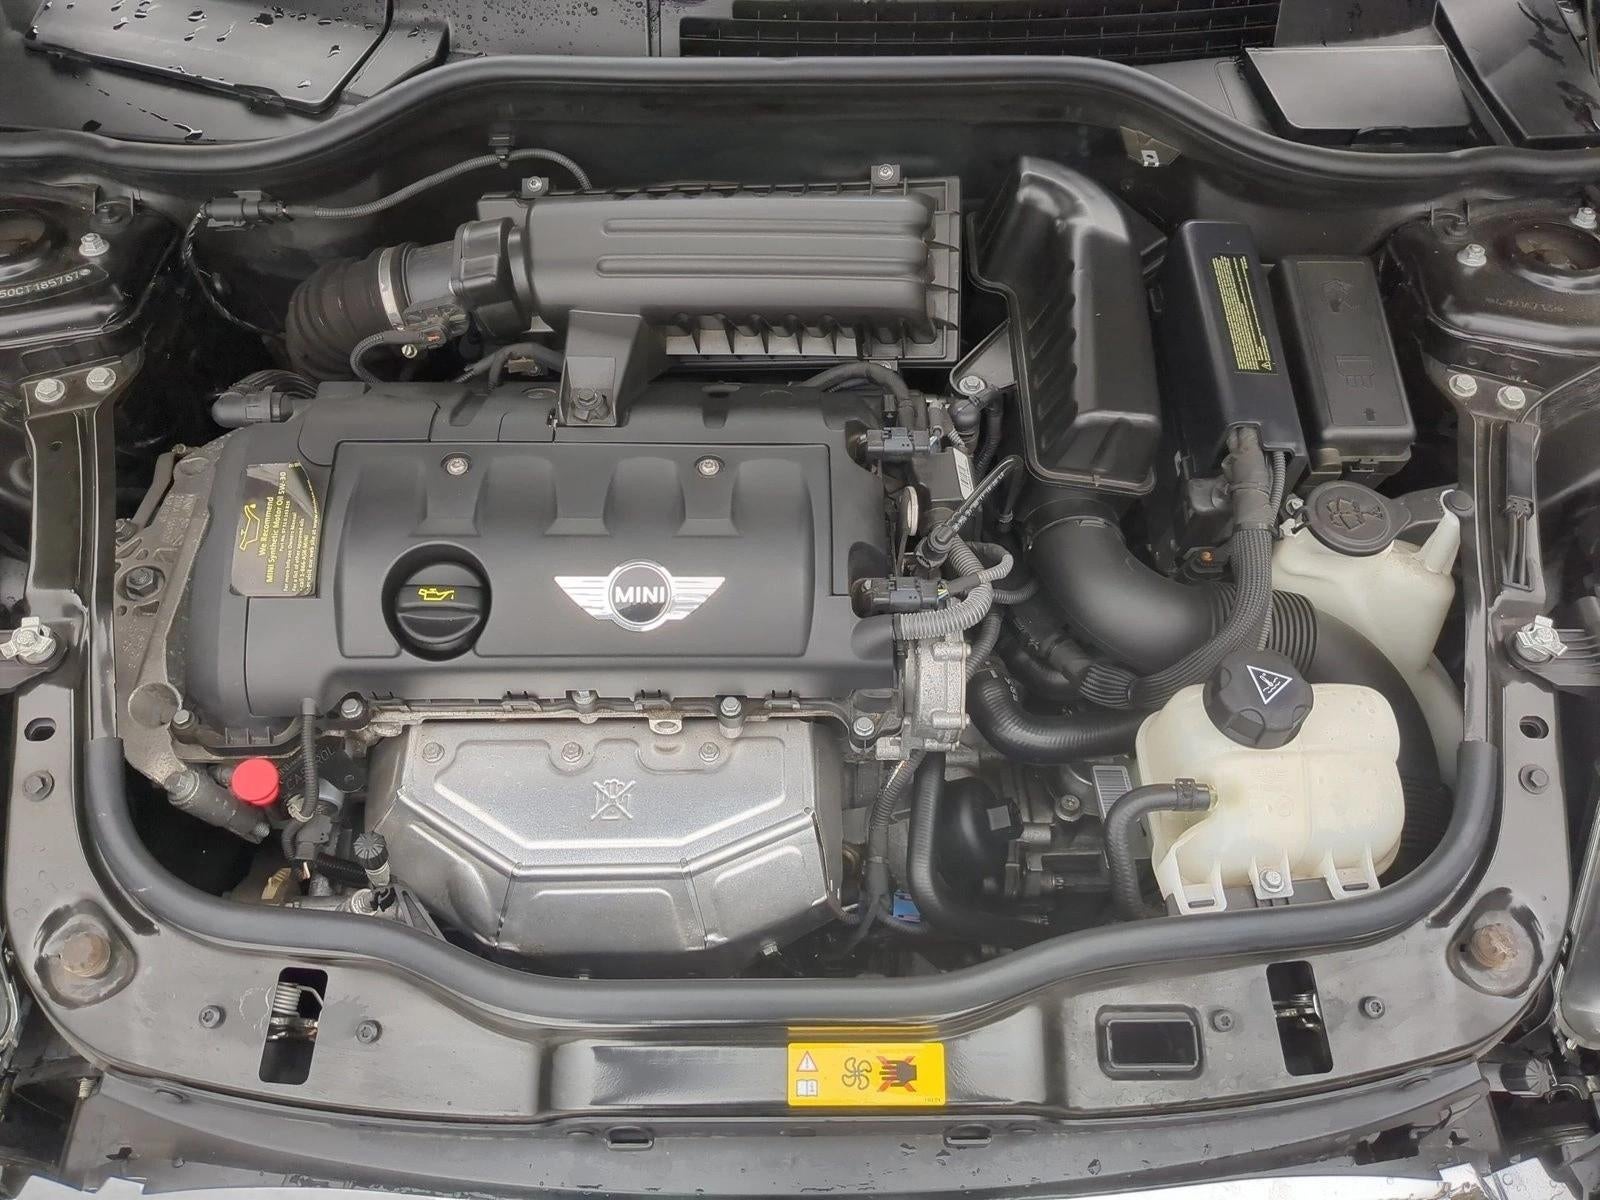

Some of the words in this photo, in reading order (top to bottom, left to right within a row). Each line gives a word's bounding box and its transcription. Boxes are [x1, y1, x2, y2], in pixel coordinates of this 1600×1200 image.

[260, 497, 273, 541] Recommend
[268, 530, 278, 563] Synthetic
[273, 507, 282, 528] Motor
[278, 472, 286, 494] 5W-30
[258, 544, 266, 556] We
[614, 586, 666, 604] MINI
[287, 746, 335, 791] CASROL
